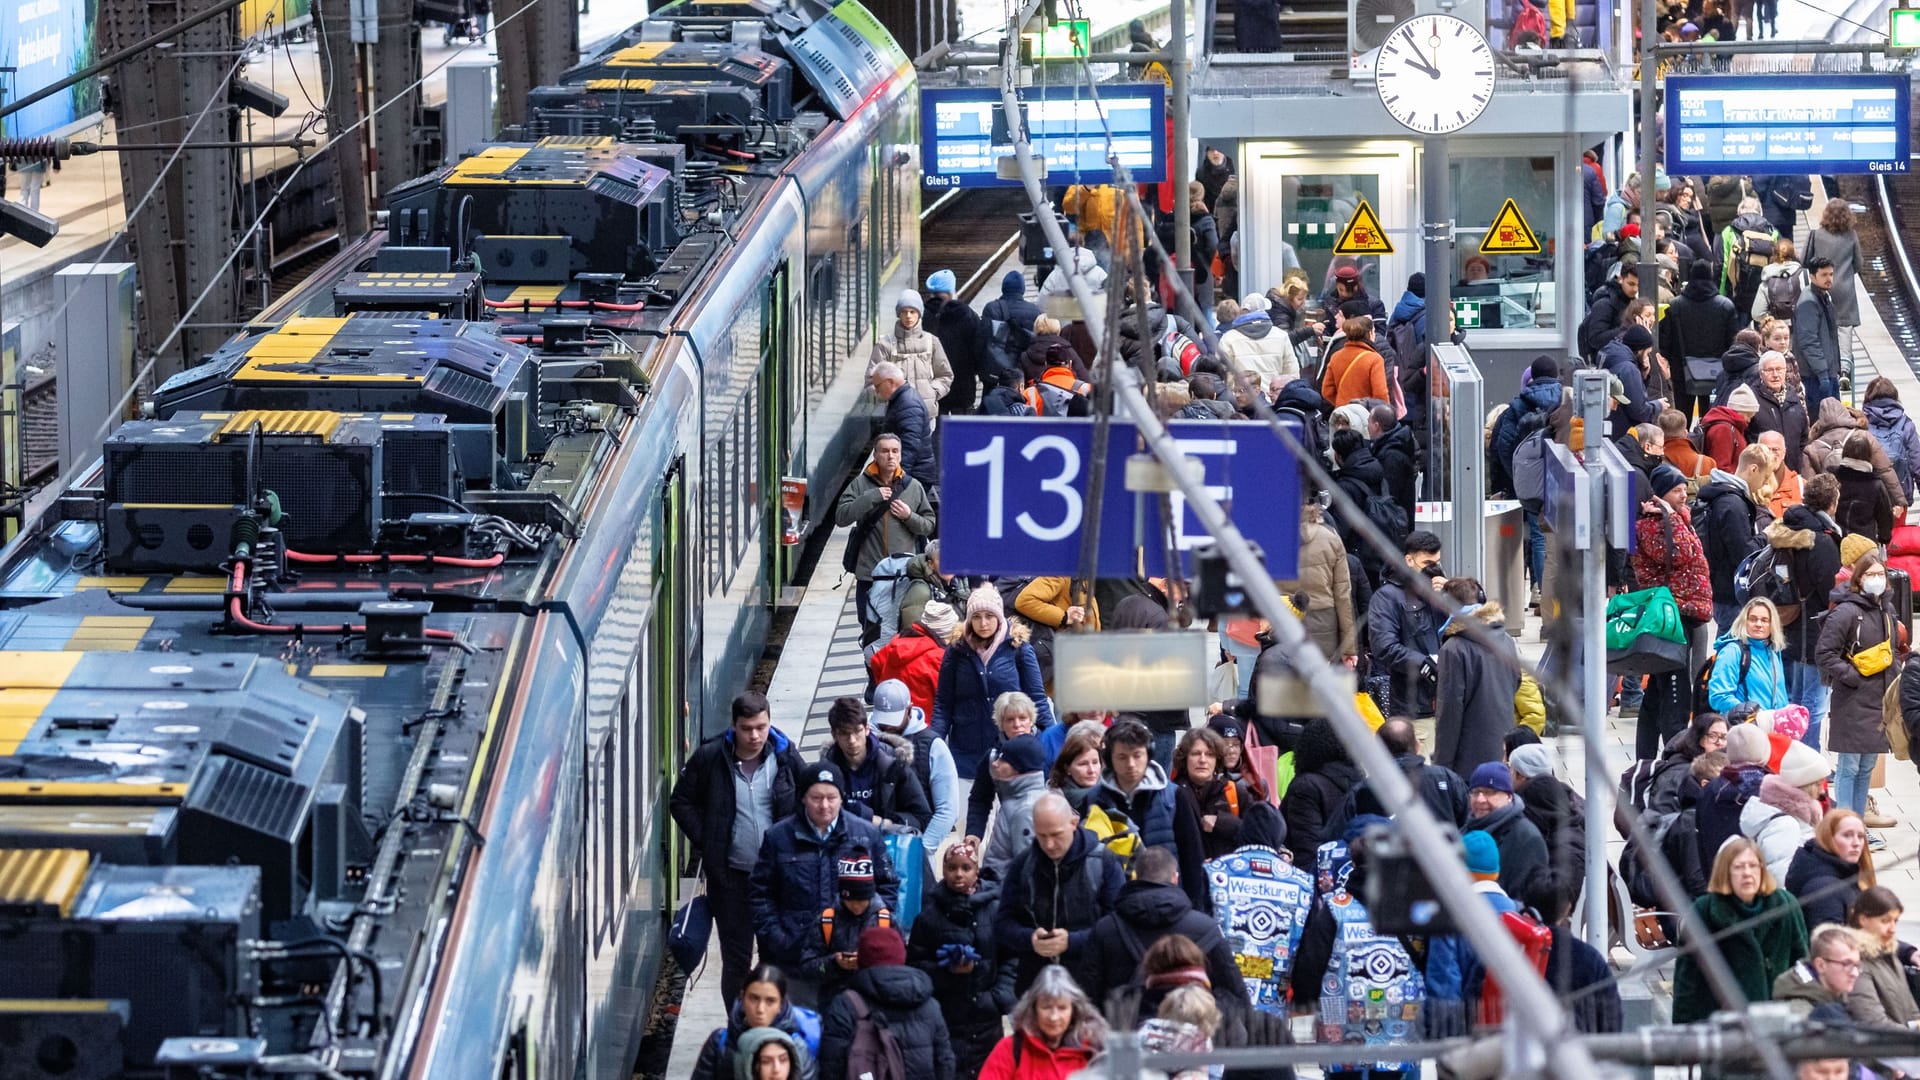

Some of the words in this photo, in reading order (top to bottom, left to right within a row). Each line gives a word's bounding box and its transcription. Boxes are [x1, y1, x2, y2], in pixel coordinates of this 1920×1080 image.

[1869, 161, 1892, 171] Gleis
[1895, 161, 1905, 170] 14
[926, 176, 949, 185] Gleis
[951, 175, 960, 184] 13
[964, 434, 1083, 541] 13
[1169, 439, 1237, 551] E
[1230, 878, 1297, 901] Westkurve
